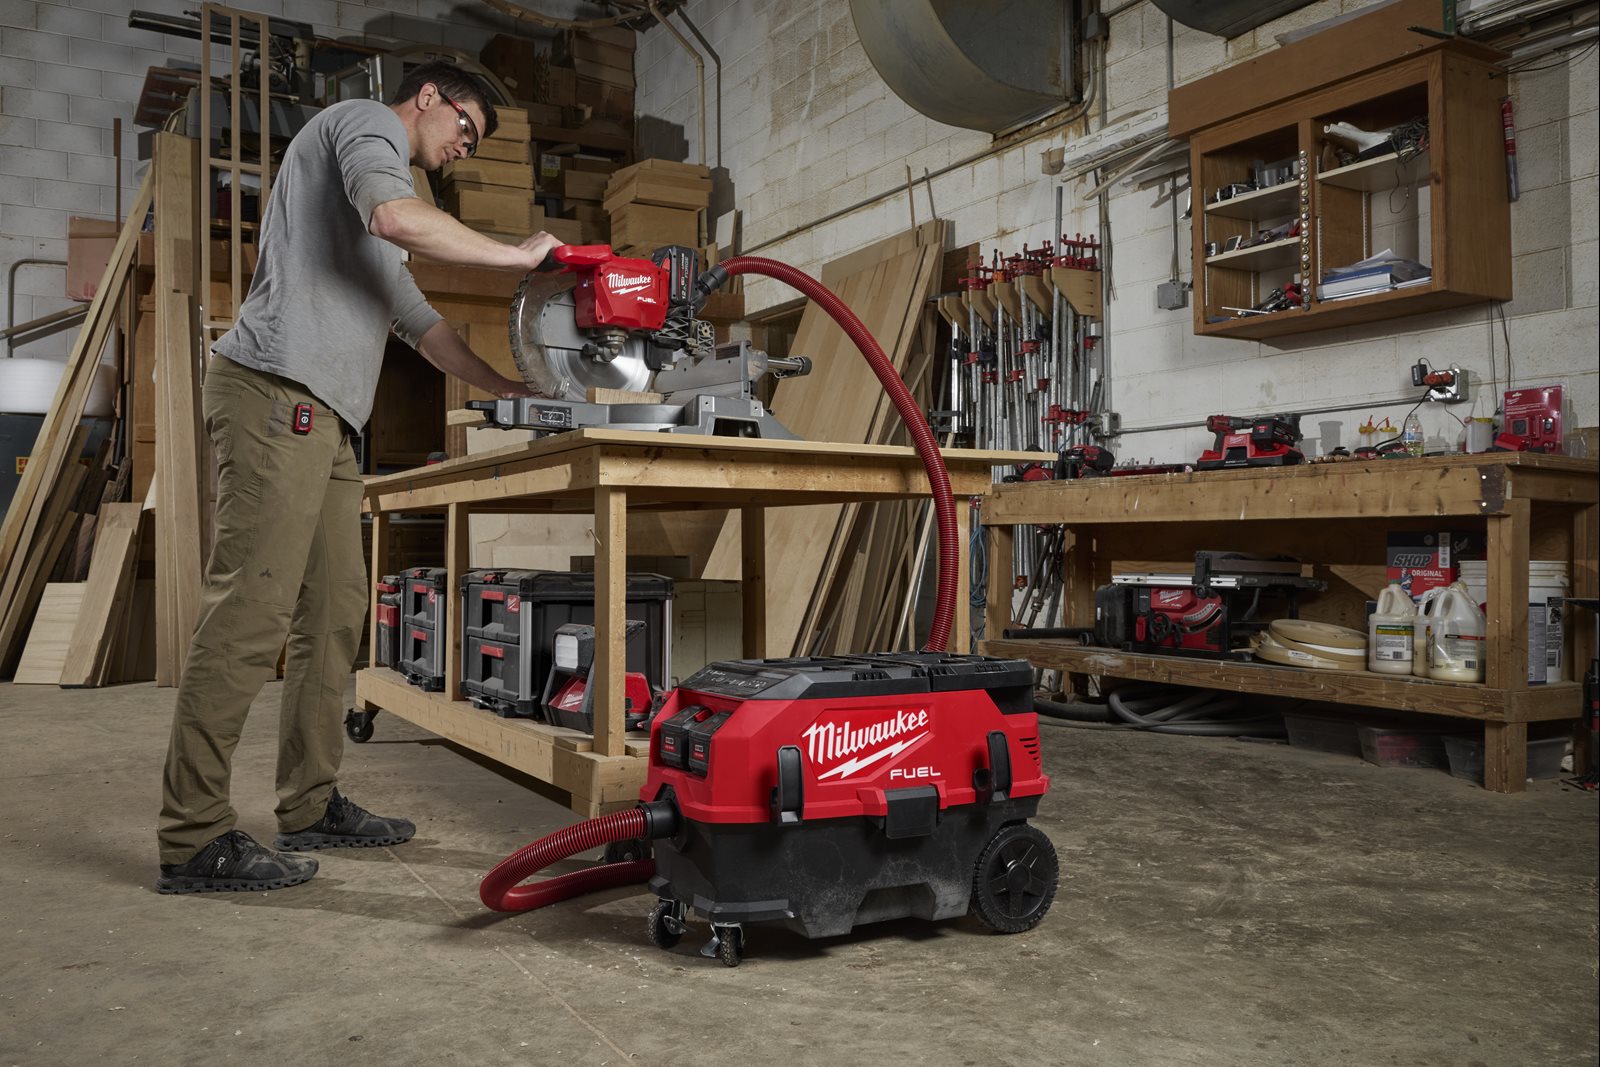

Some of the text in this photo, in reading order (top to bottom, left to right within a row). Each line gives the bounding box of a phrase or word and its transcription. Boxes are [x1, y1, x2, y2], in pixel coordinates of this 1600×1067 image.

[606, 272, 652, 288] Milwaukee
[637, 296, 657, 304] FUEL
[1394, 554, 1432, 568] SHOP
[1411, 569, 1443, 577] ORIGINAL
[802, 709, 929, 765] Milwaukee
[890, 766, 942, 780] FUEL
